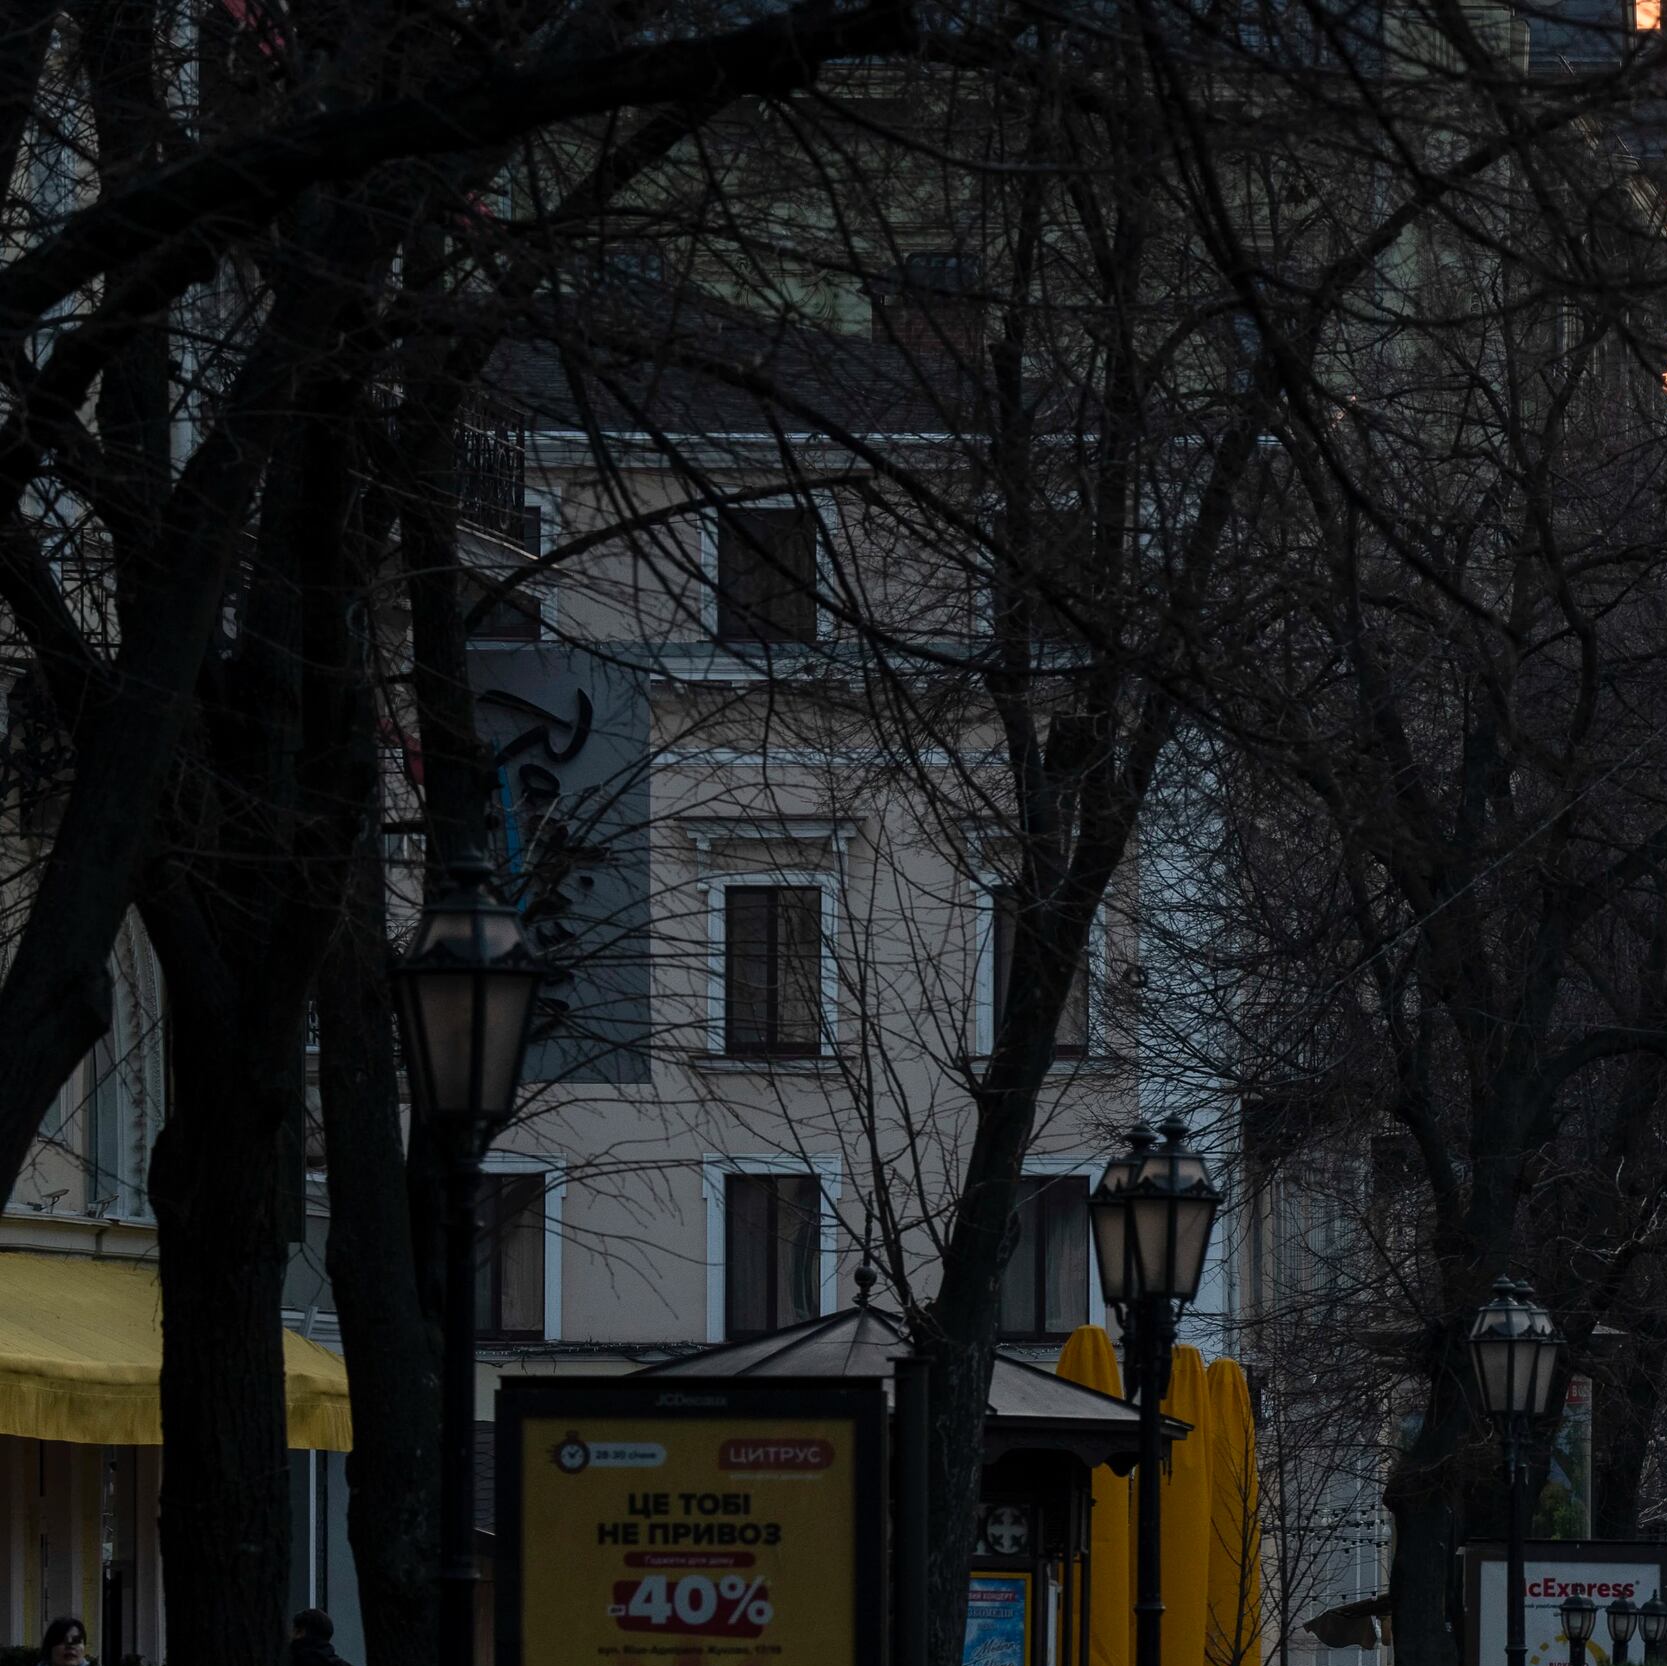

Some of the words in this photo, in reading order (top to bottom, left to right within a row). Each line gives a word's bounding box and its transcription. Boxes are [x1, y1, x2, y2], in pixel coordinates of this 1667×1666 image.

[729, 1446, 822, 1465] ЦИТРУС
[628, 1493, 669, 1519] ЦЕ
[678, 1493, 751, 1516] ТОБІ
[598, 1523, 639, 1546] НЕ
[648, 1523, 782, 1546] ПРИВОЗ
[1523, 1577, 1635, 1599] cExpress
